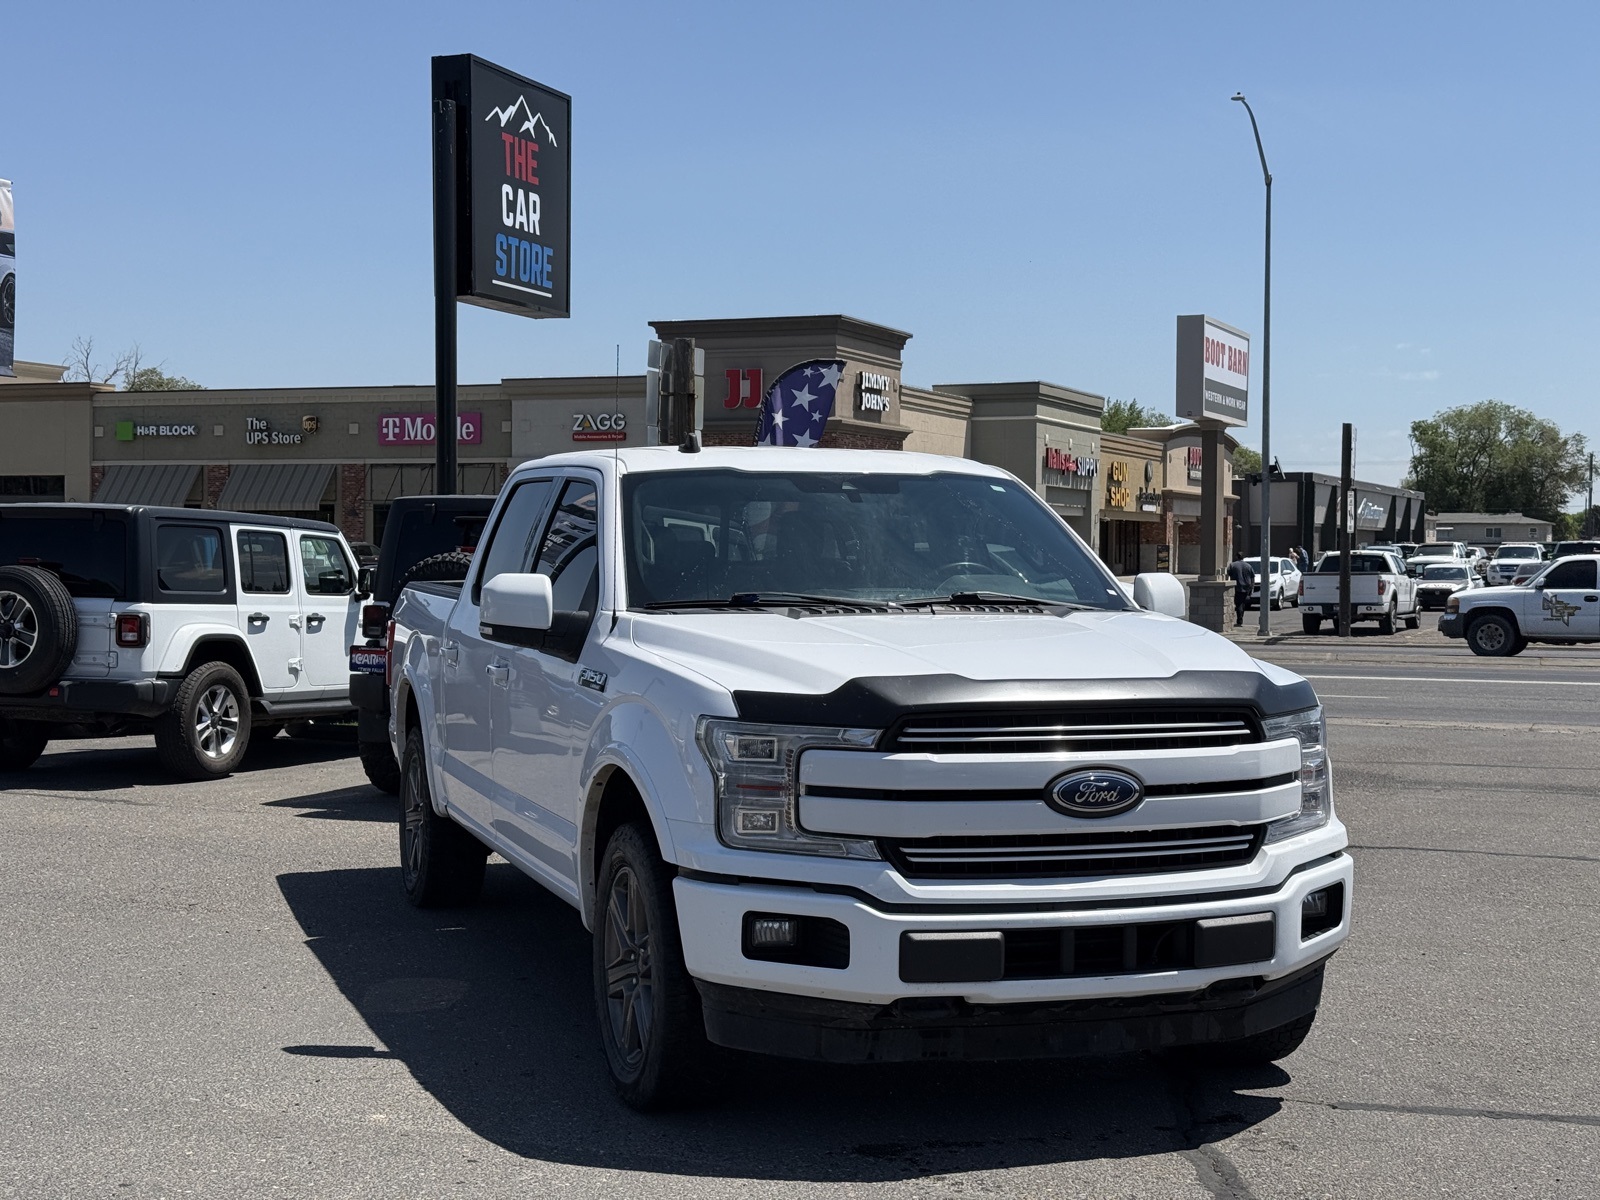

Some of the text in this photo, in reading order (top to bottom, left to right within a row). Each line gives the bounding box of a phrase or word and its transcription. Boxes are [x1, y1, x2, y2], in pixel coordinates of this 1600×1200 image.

[501, 132, 540, 185] THE
[502, 184, 541, 235] CAR
[495, 233, 553, 289] STORE
[1205, 336, 1248, 377] BOOT BARN
[862, 371, 890, 391] JIMMY
[861, 392, 890, 412] JOHN'S
[137, 424, 195, 436] H&R BLOCK
[246, 417, 267, 430] The
[572, 413, 626, 431] ZAGG
[246, 431, 301, 445] UPS Store
[1077, 457, 1100, 477] SUPPLY
[1112, 461, 1130, 482] GUN
[1110, 486, 1130, 507] SHOP
[1075, 781, 1120, 803] Ford
